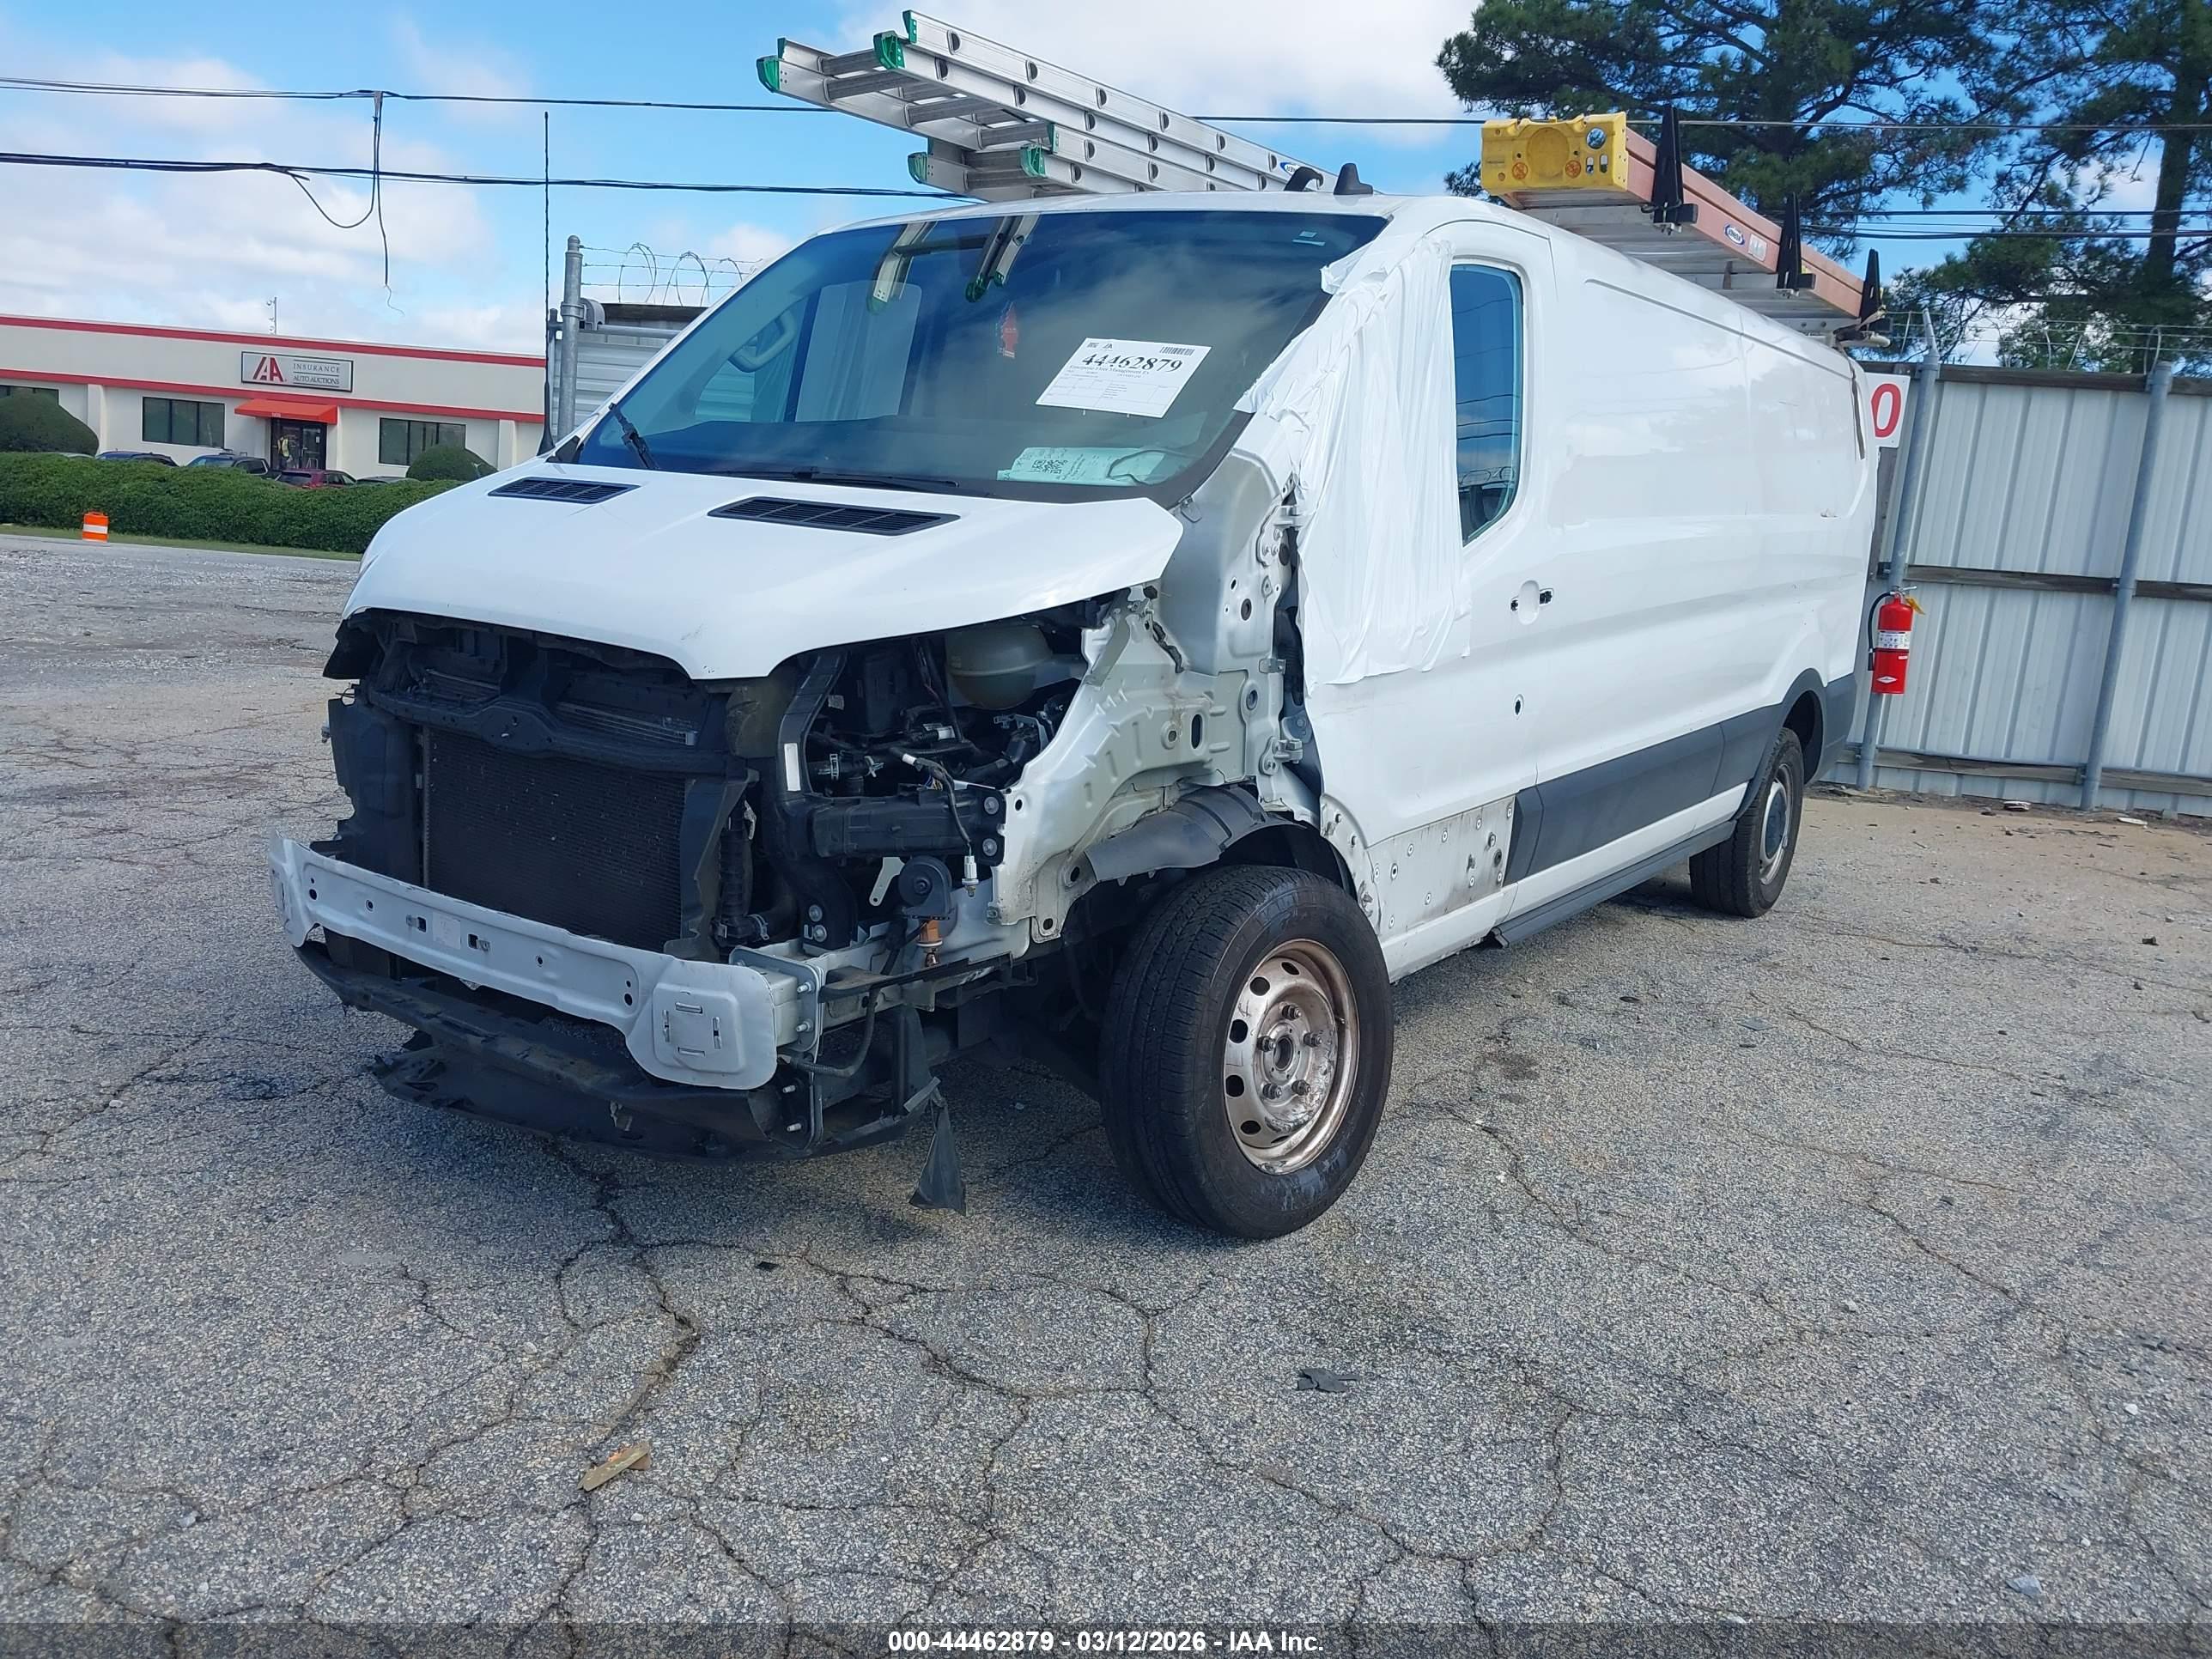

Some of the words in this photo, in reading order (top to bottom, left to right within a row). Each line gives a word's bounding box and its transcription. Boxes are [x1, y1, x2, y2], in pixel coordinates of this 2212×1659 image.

[293, 363, 340, 374] INSURANCE
[1082, 353, 1183, 373] 44462879
[310, 377, 340, 386] AUCTIONS
[1870, 383, 1901, 438] 0
